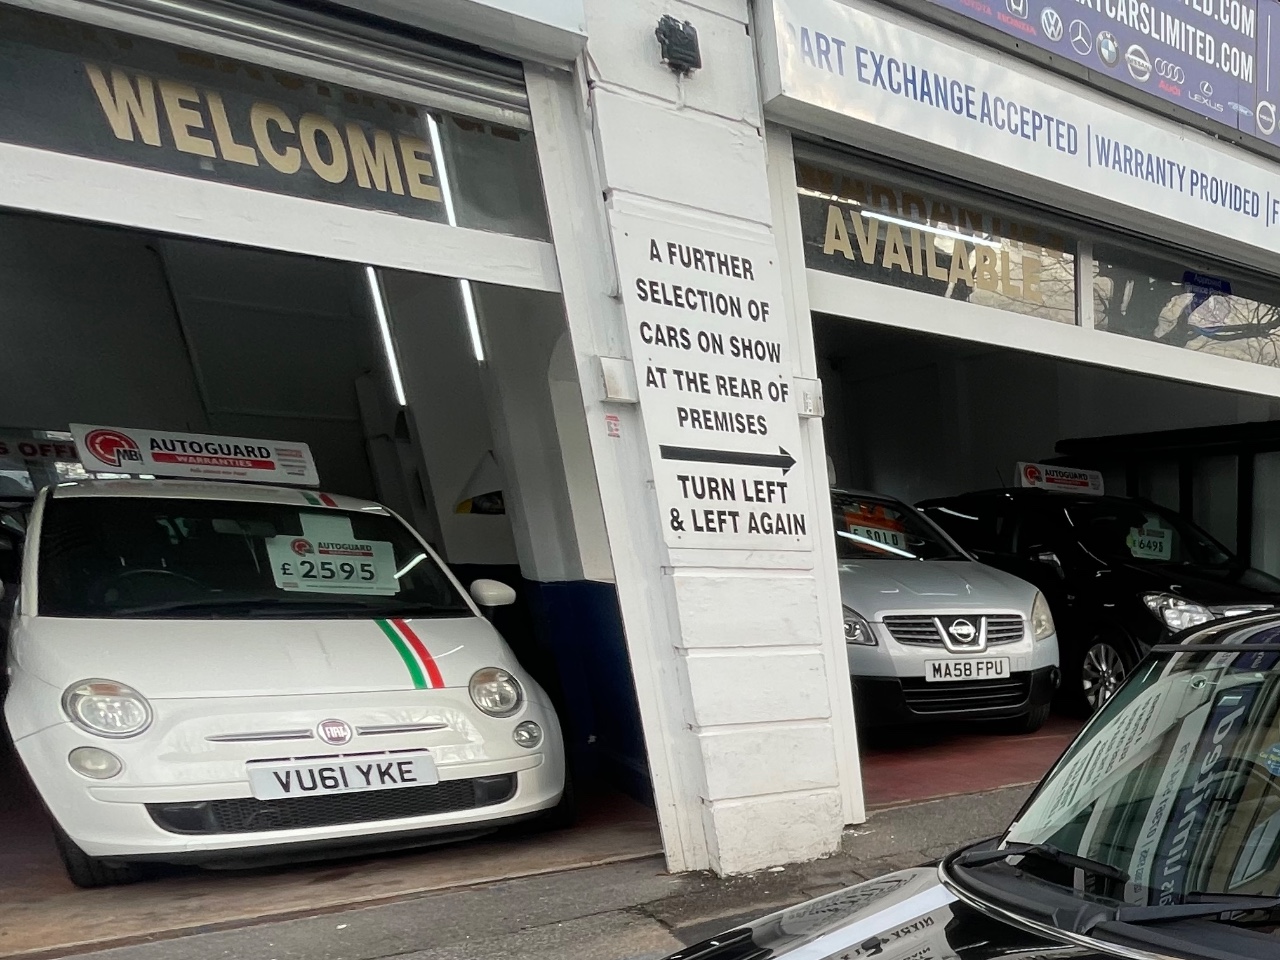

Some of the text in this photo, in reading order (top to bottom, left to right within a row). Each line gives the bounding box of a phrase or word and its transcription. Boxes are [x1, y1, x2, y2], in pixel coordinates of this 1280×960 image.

[1188, 91, 1224, 114] LEXUS
[83, 61, 444, 204] WELCOME
[855, 46, 977, 121] EXCHANGE
[979, 91, 1079, 157] ACCEPTED
[1095, 133, 1186, 194] WARRANTY
[1189, 170, 1260, 218] PROVIDED
[649, 238, 755, 281] A FURTHER
[823, 204, 1044, 303] AVAILABLE
[636, 278, 770, 323] SELECTION OF
[639, 321, 781, 364] CARS ON SHOW
[646, 366, 789, 403] AT THE REAR OF
[677, 407, 768, 436] PREMISES
[149, 437, 272, 460] AUTOGUARD
[175, 453, 253, 468] WARRANTIES
[1045, 468, 1089, 481] AUTOGUARD
[677, 475, 788, 504] TURN LEFT
[670, 508, 807, 536] & LEFT AGAIN
[318, 541, 373, 552] AUTOGUARD
[866, 529, 899, 547] SOLD
[280, 560, 376, 581] £ 2595
[932, 659, 1003, 679] MA58 FPU
[273, 761, 418, 793] VU61 YKE
